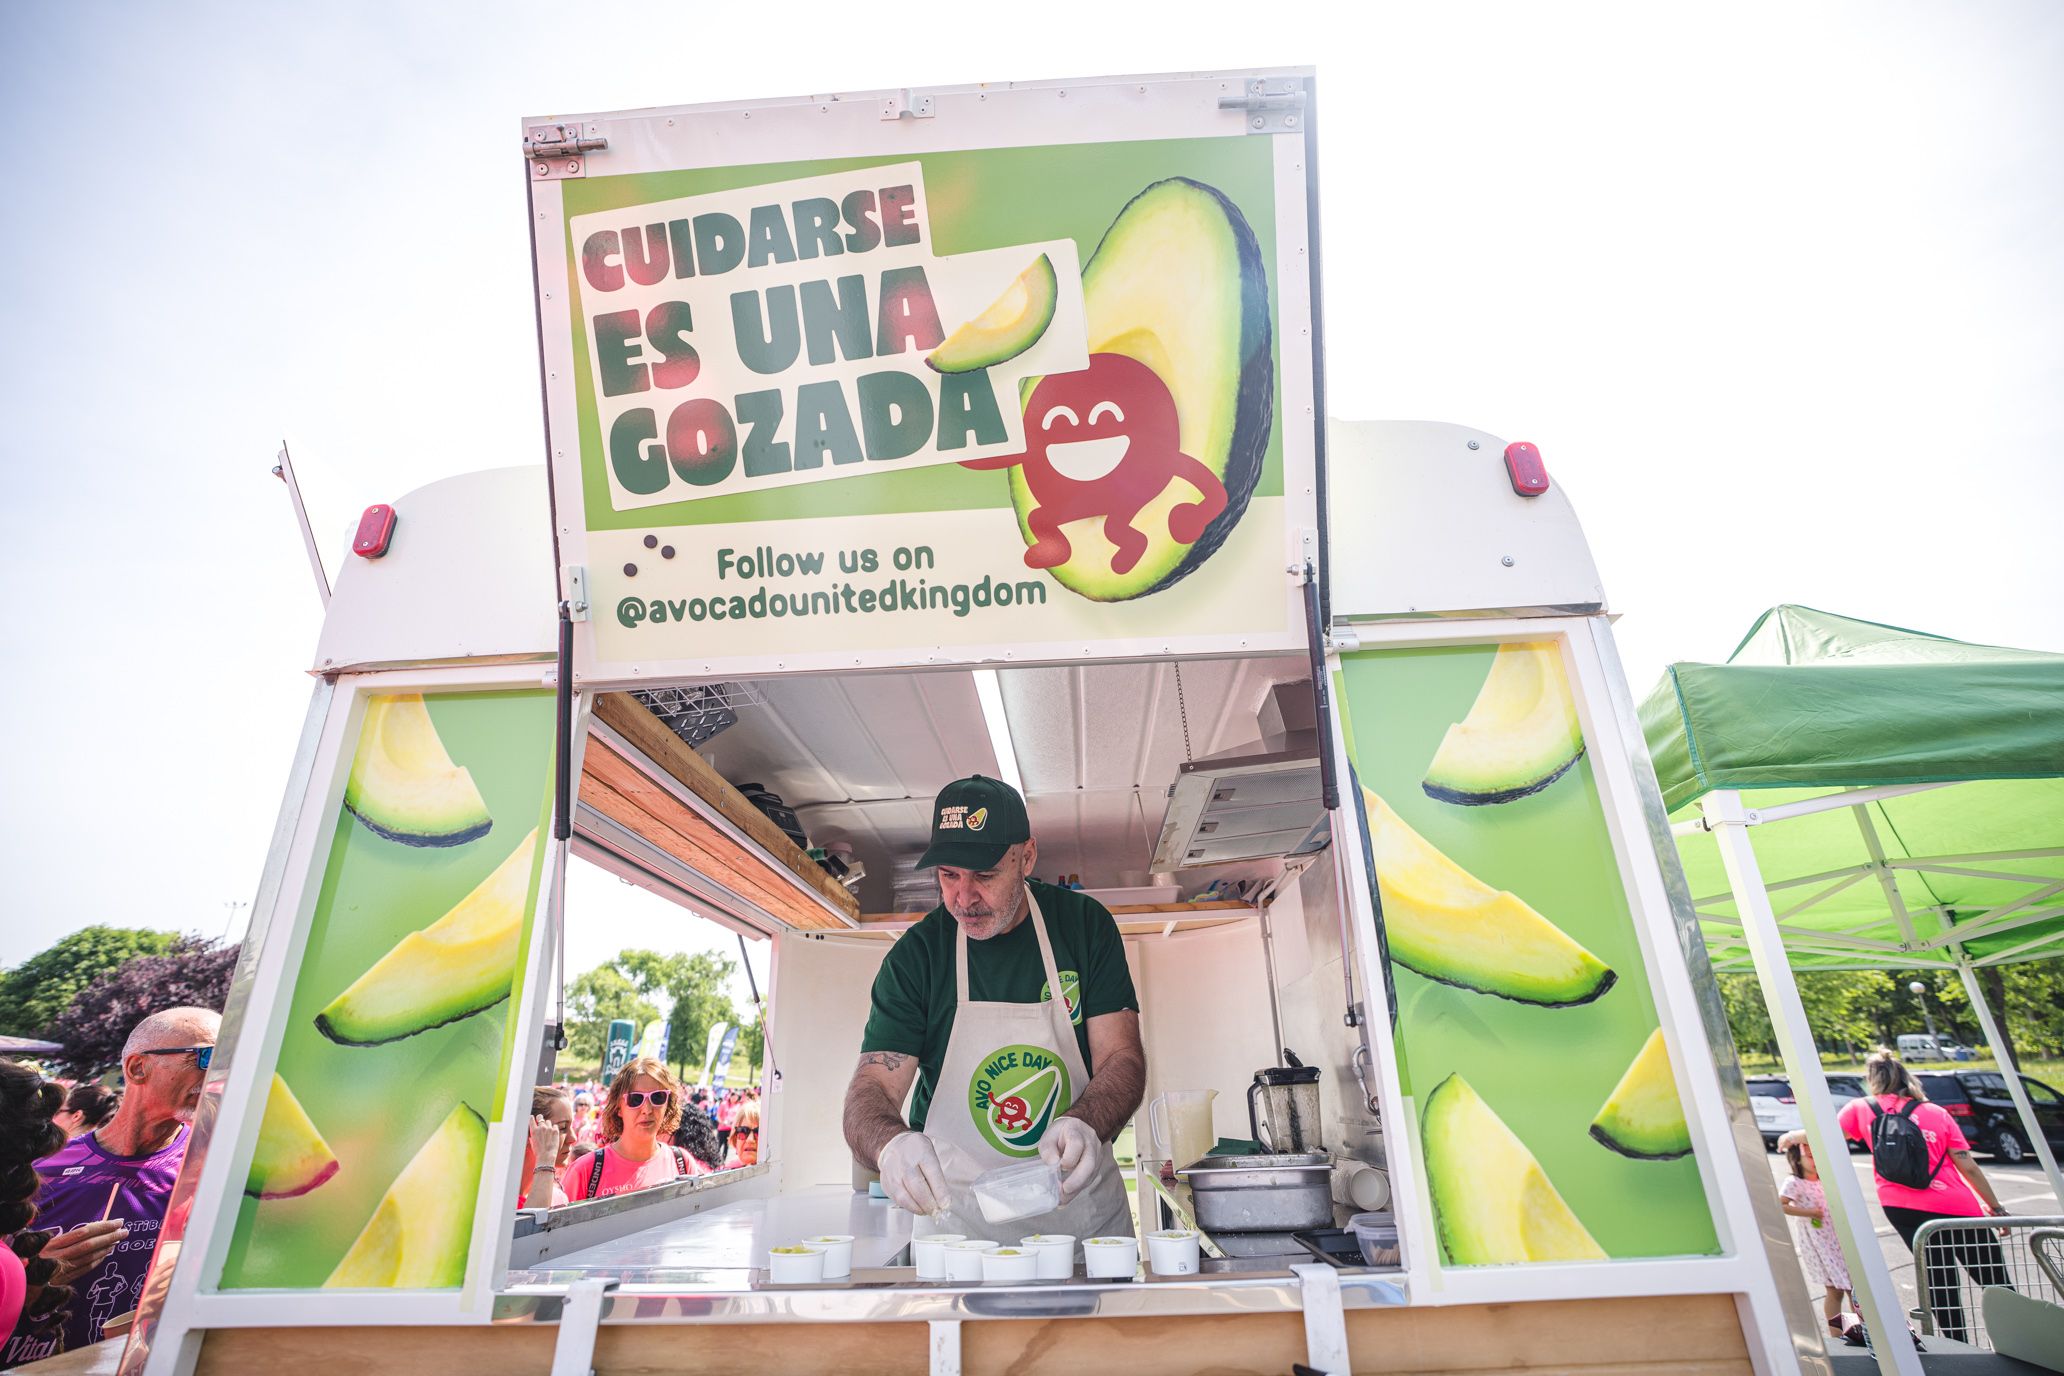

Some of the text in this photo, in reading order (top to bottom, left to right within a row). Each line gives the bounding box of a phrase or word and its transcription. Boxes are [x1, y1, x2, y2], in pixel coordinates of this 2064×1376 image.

[581, 183, 922, 293] CUIDARSE
[592, 265, 946, 398] ES UNA
[609, 367, 1009, 496] GOZADA
[616, 573, 1047, 629] @avocadounitedkingdom
[716, 544, 935, 580] Follow us on
[975, 1051, 1053, 1110] AVO NICE DAY
